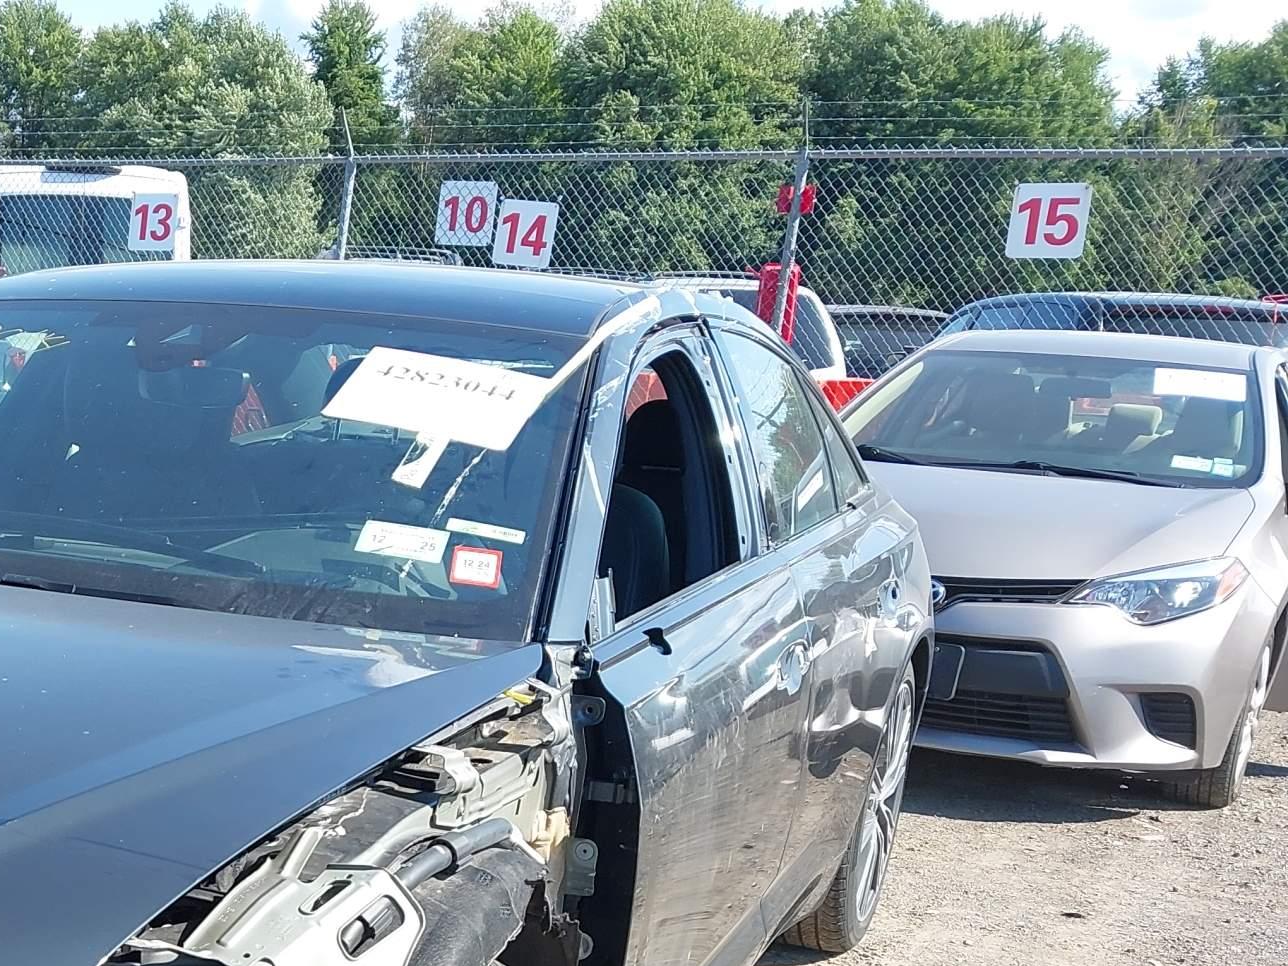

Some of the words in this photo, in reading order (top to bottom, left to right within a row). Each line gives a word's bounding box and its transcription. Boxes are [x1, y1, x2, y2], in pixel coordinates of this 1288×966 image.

[135, 203, 173, 241] 13
[444, 195, 488, 233] 10
[1018, 197, 1081, 246] 15
[502, 212, 548, 256] 14
[377, 365, 516, 401] 42823044
